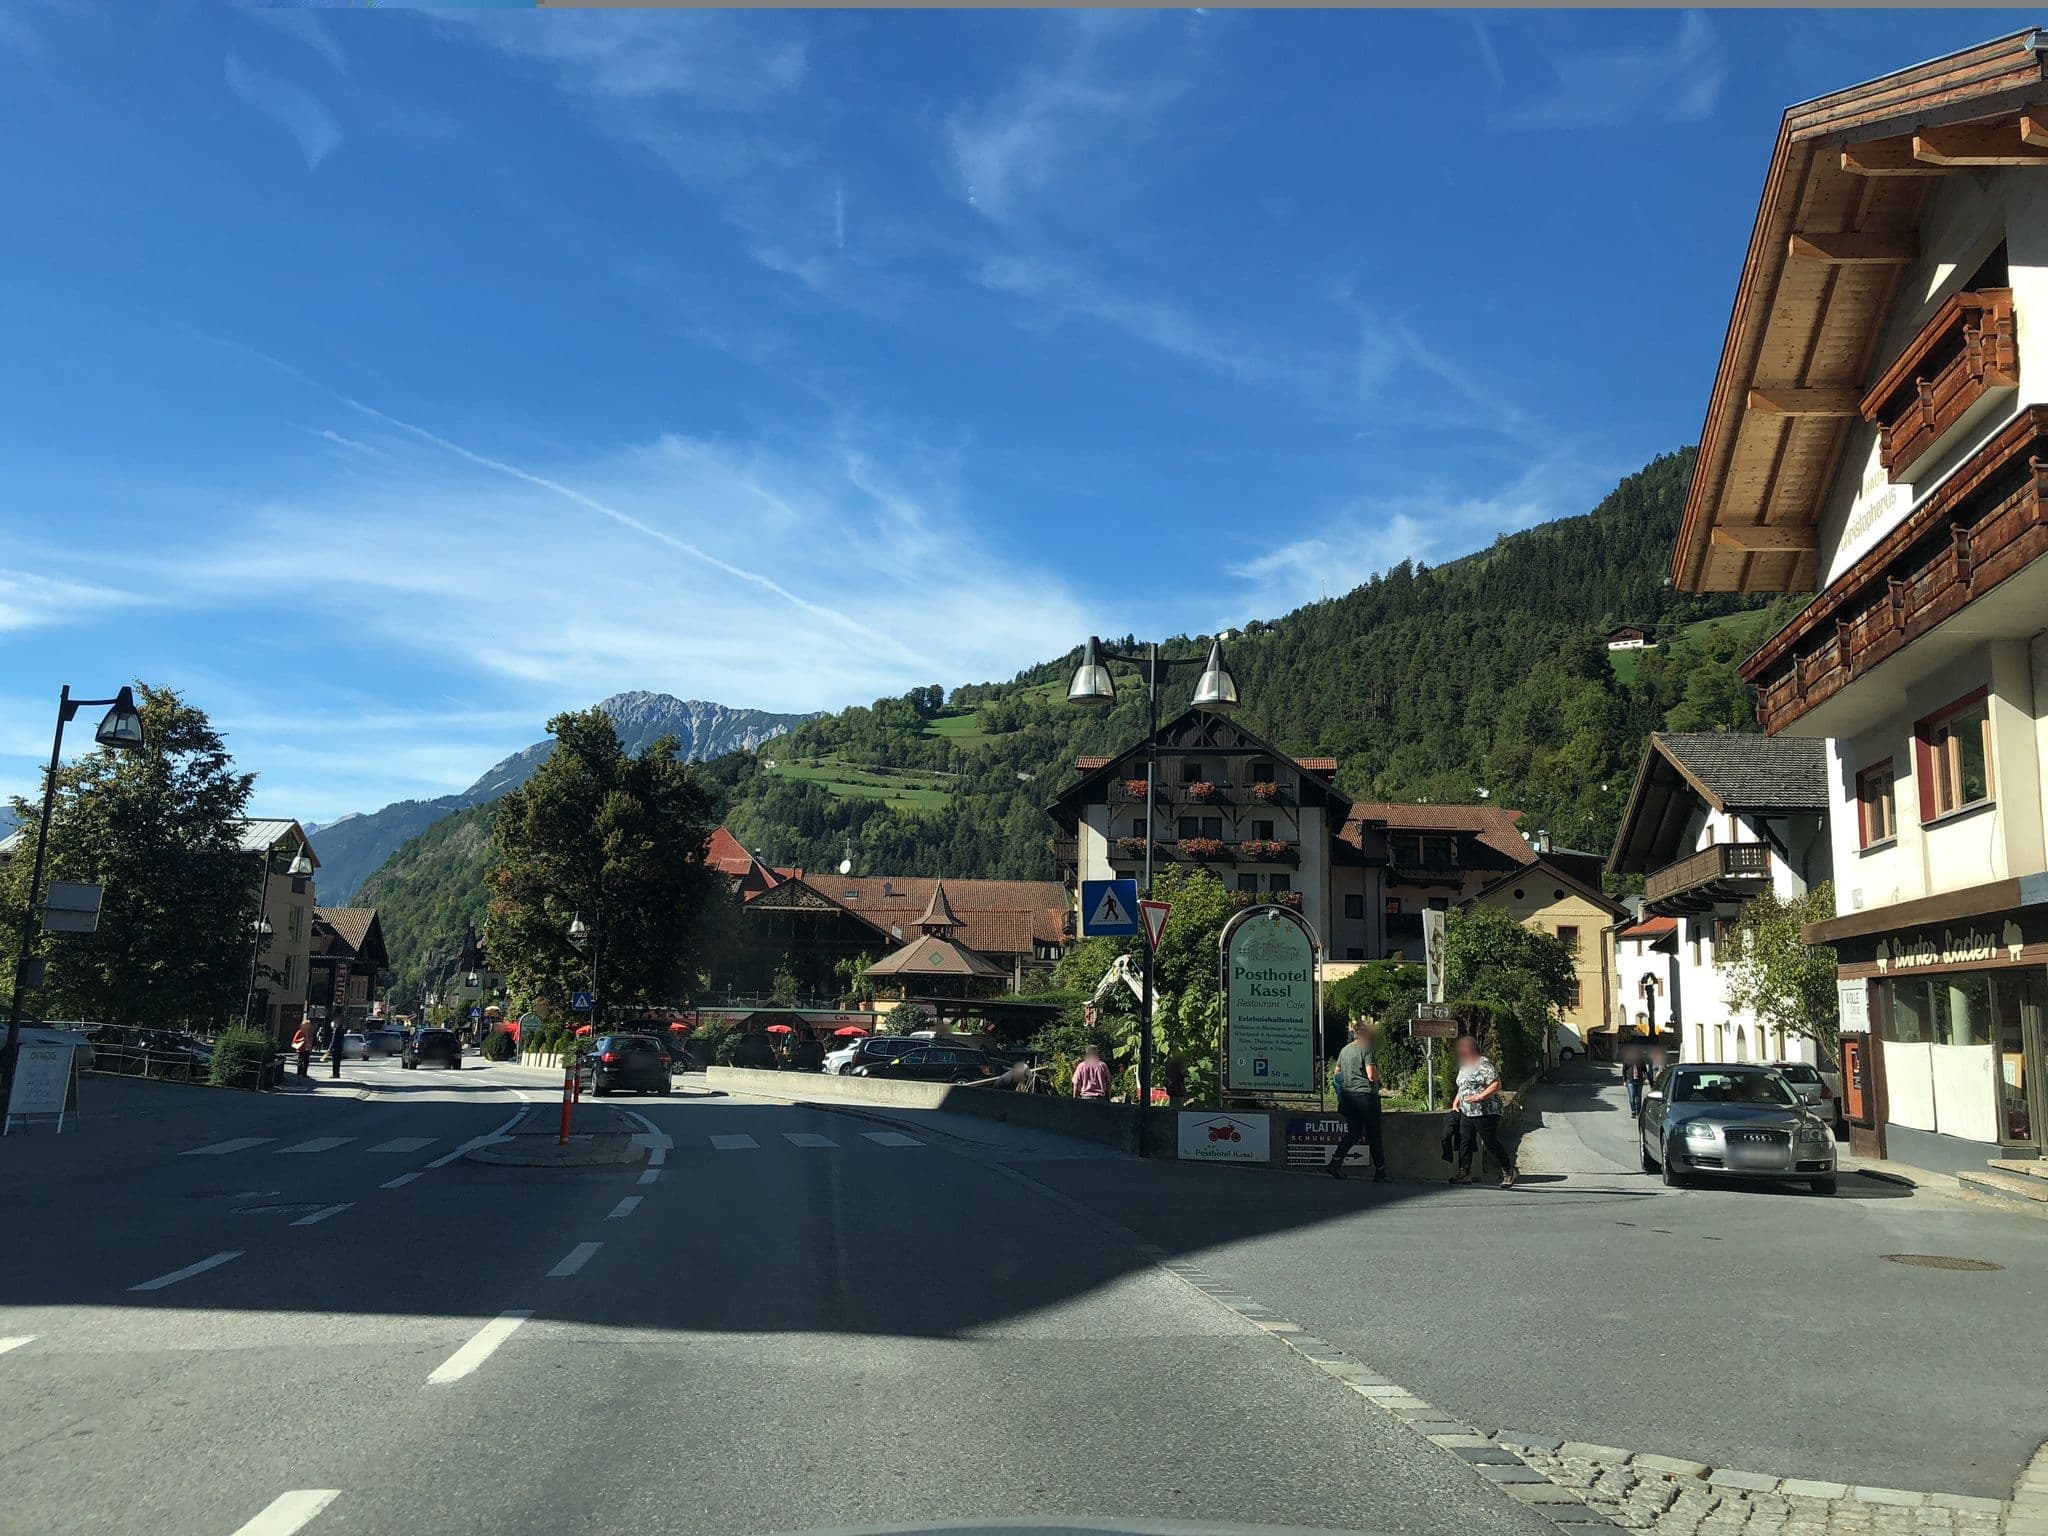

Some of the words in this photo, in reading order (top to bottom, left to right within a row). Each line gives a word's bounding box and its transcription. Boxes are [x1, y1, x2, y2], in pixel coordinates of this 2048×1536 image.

[1234, 966, 1307, 982] Posthotel
[1250, 983, 1291, 997] Kassl
[1236, 999, 1280, 1008] Restaurant
[1305, 1120, 1349, 1133] PLATTNE
[1195, 1149, 1231, 1158] Posthotel
